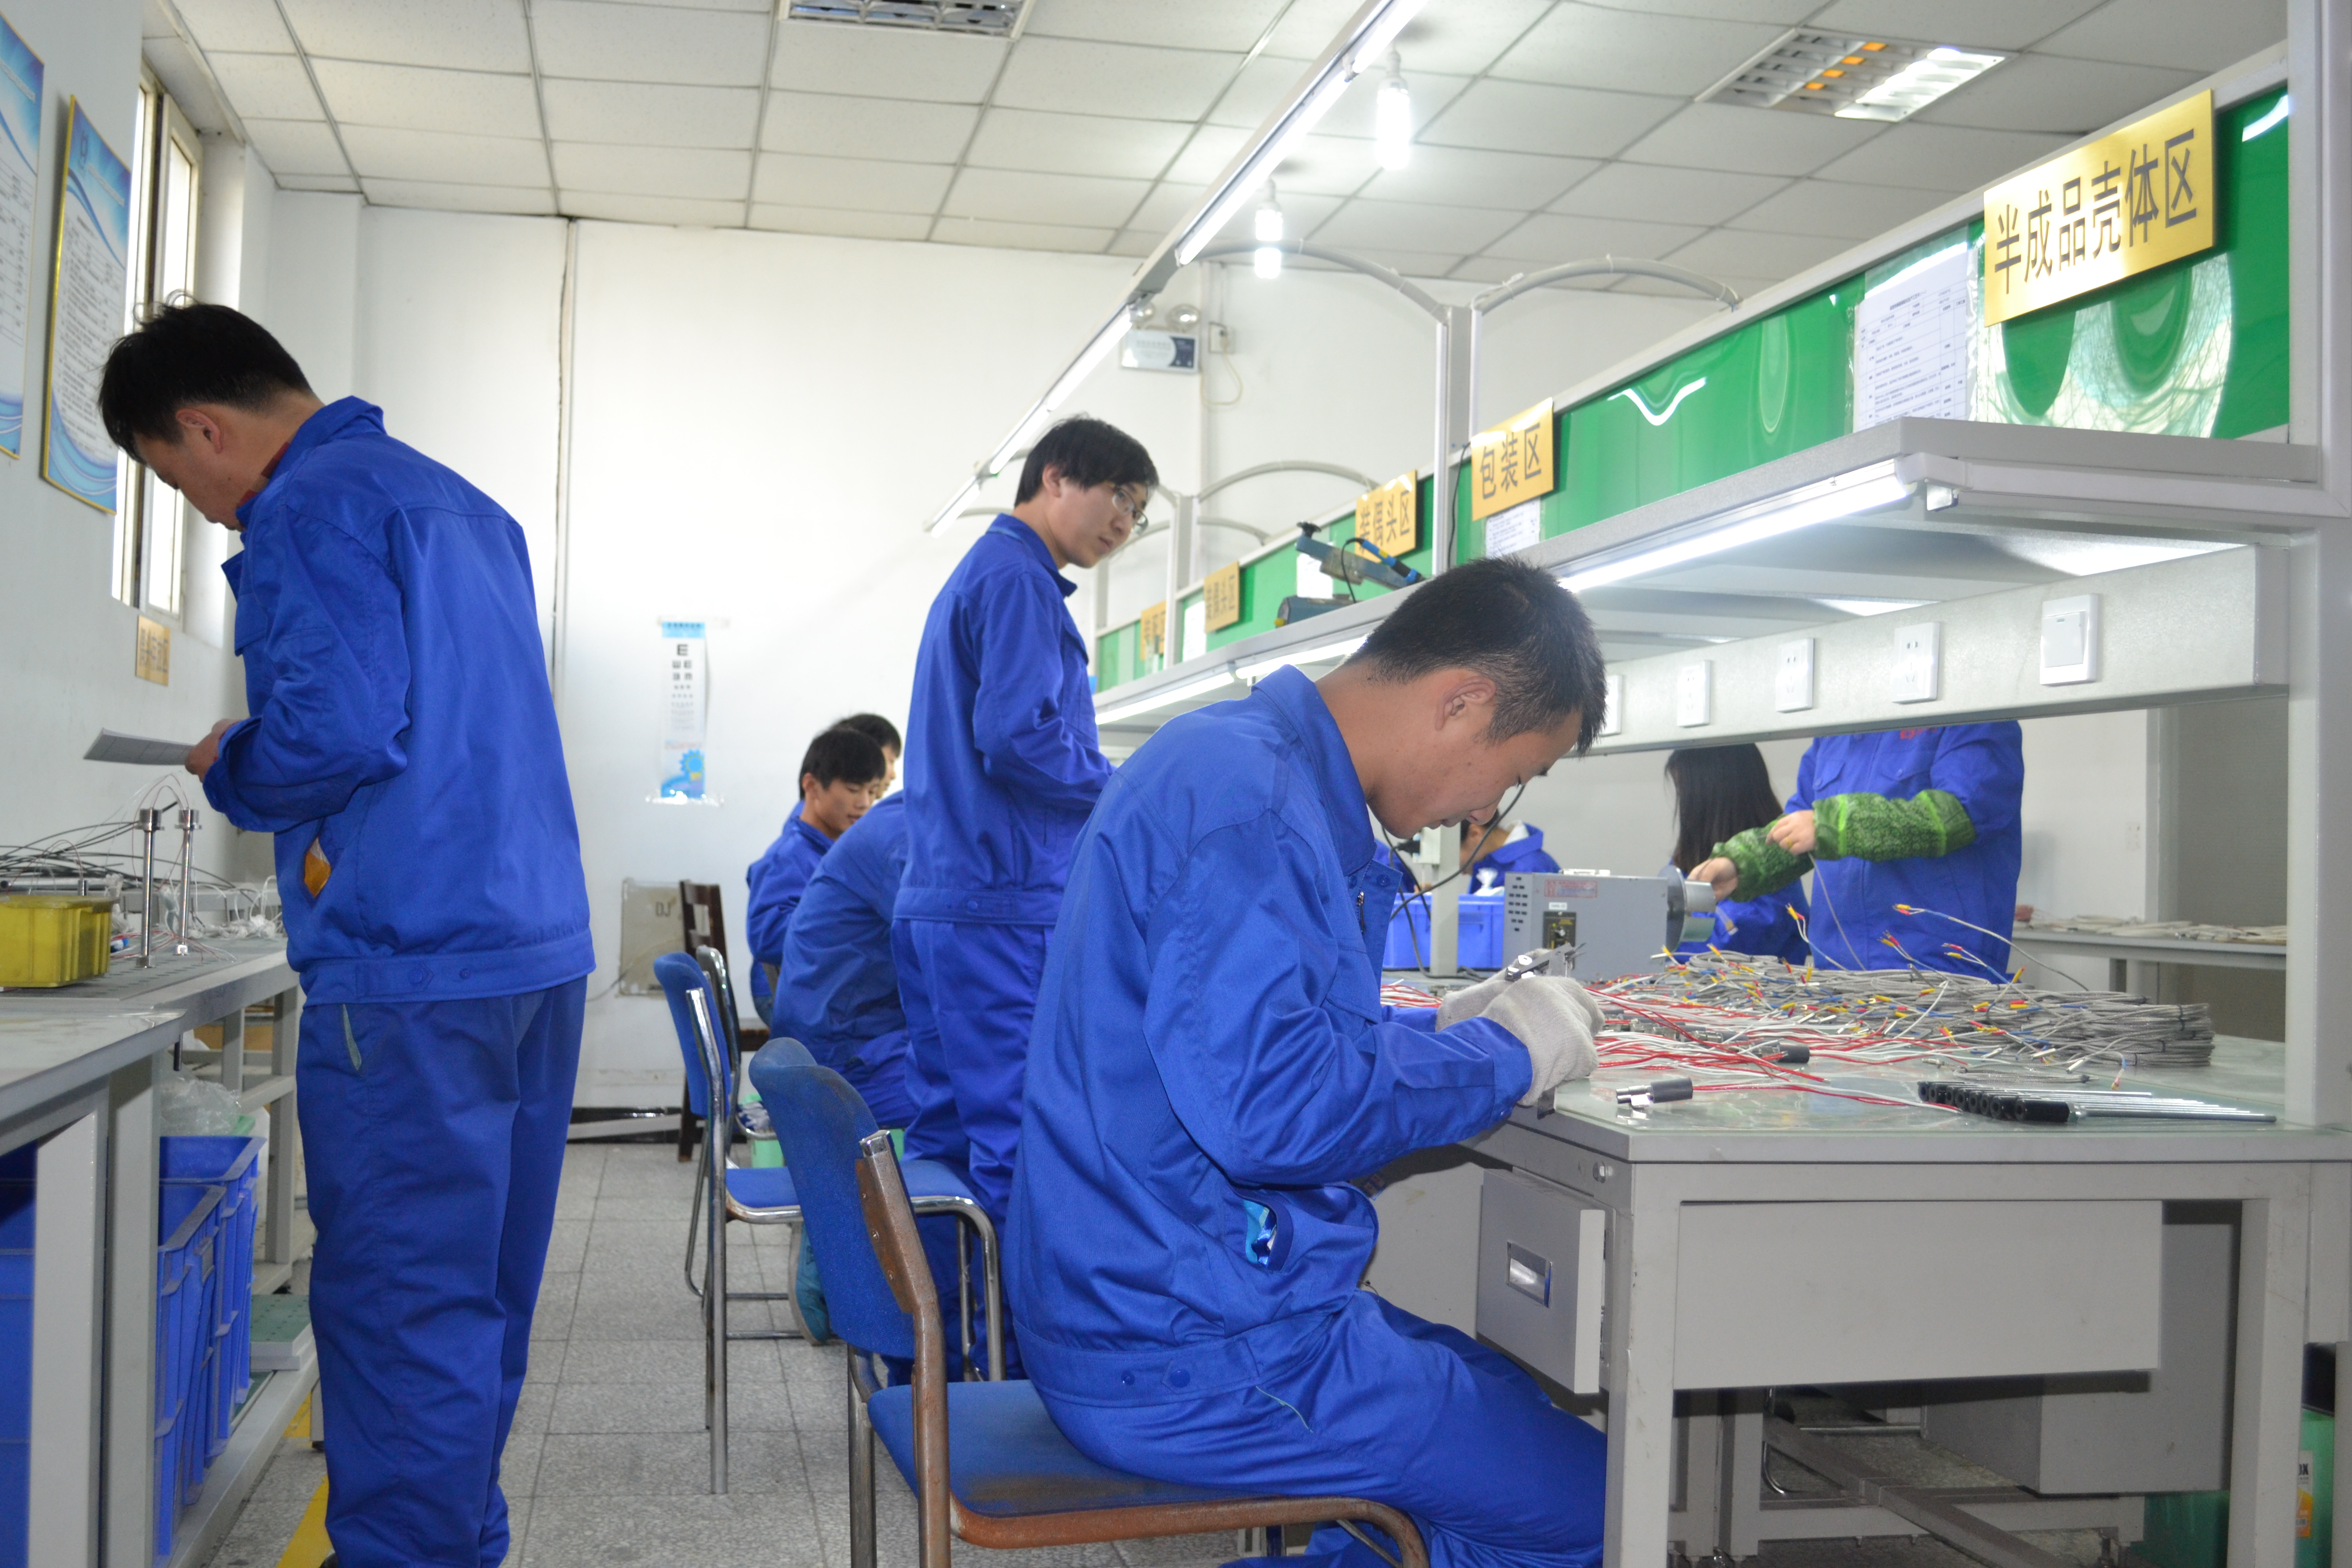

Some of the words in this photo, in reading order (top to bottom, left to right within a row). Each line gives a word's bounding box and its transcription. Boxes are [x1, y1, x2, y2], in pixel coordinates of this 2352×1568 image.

[1994, 128, 2197, 295] 半成品壳体区
[1480, 423, 1541, 499] 包装区
